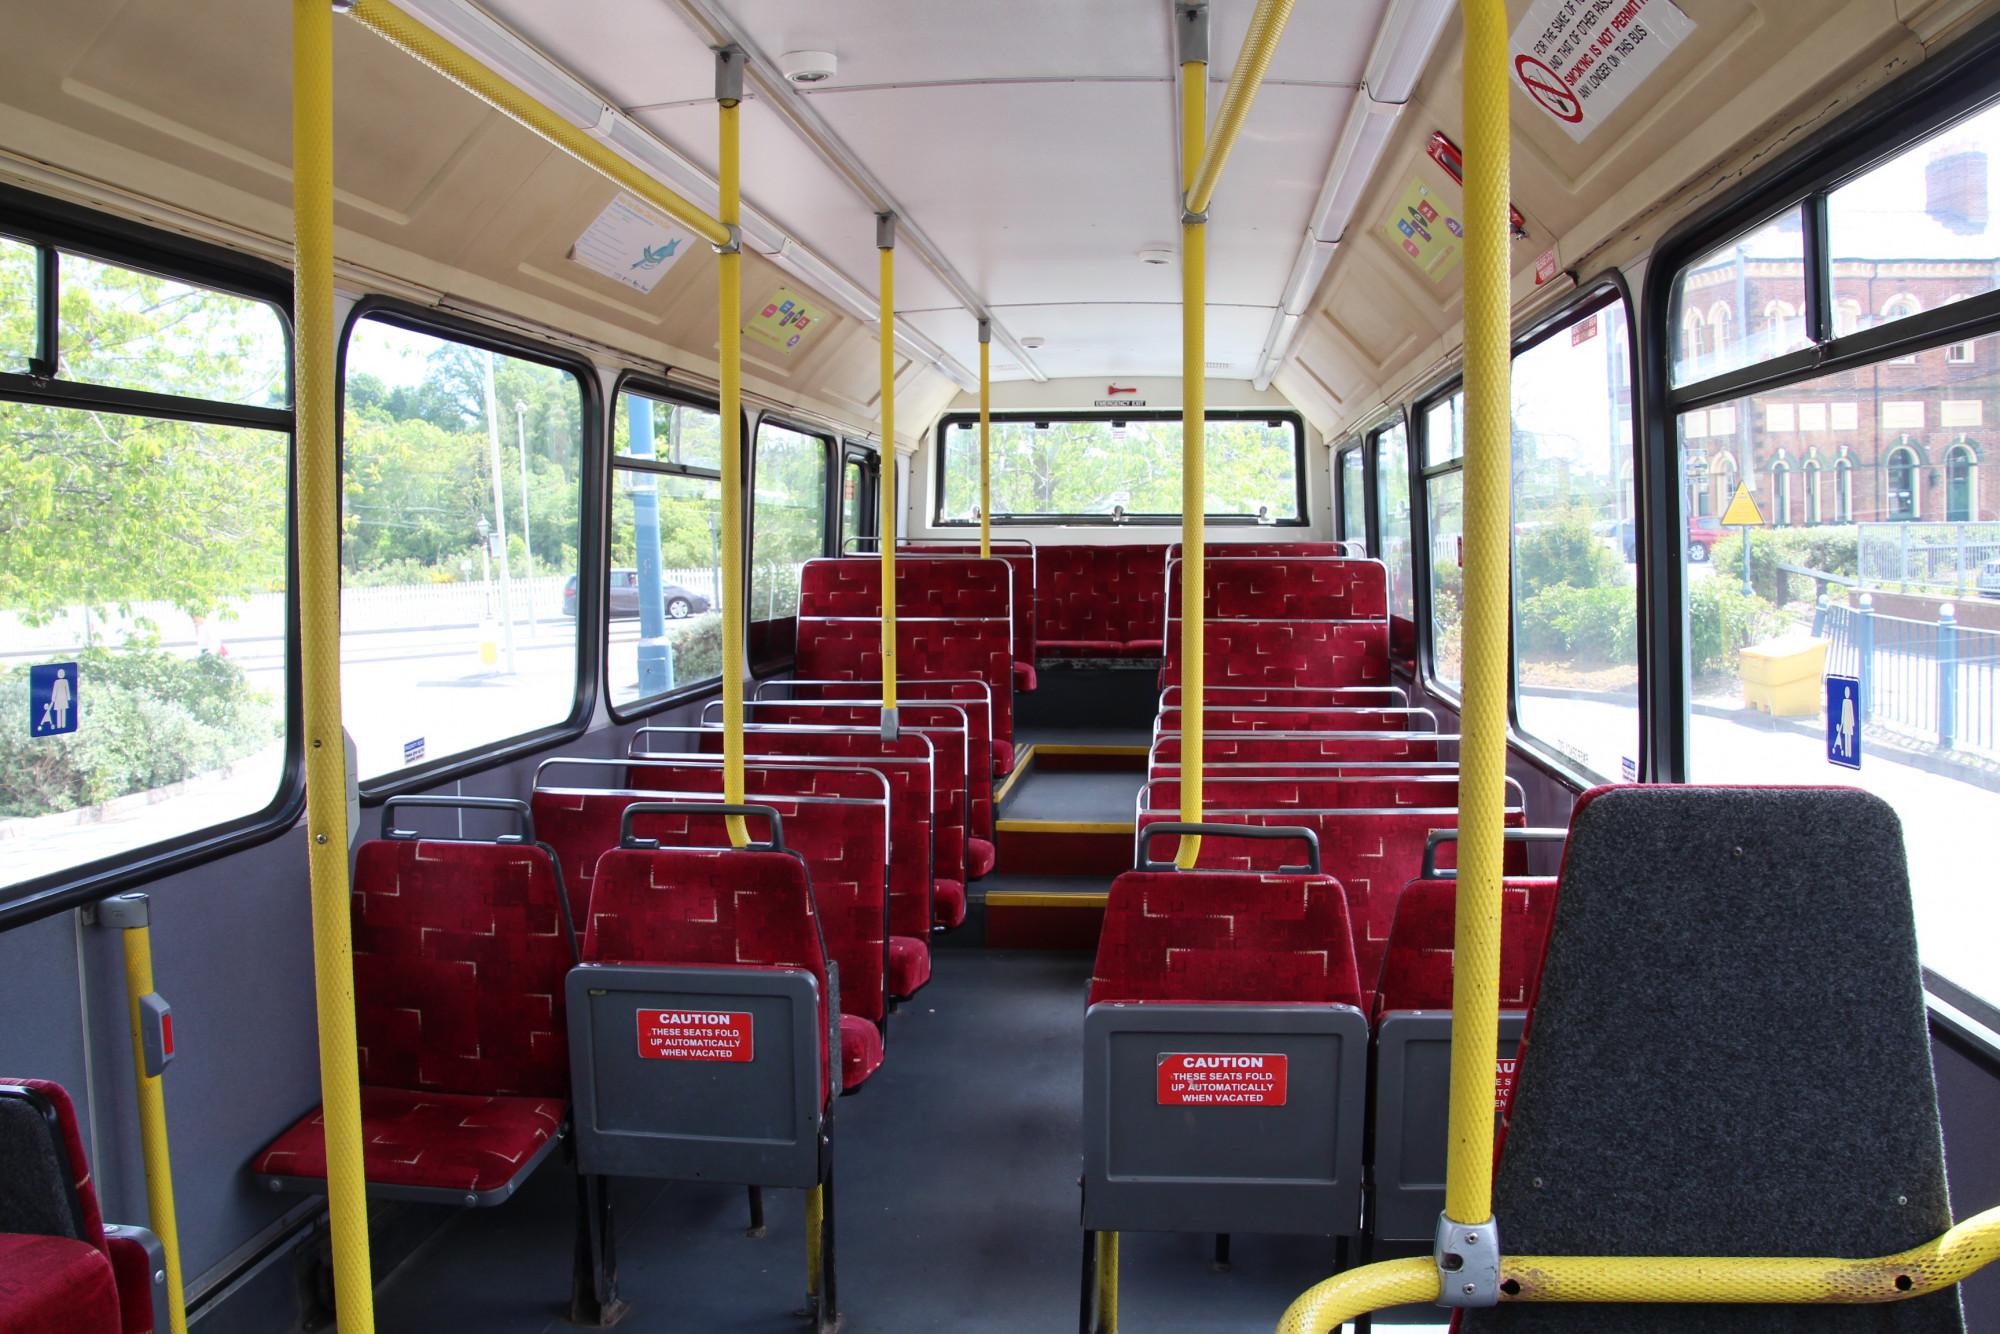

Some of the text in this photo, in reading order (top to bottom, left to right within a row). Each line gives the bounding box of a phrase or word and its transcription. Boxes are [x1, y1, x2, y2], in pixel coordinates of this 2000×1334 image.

[1533, 0, 1577, 57] FOR THE SAKE OF
[1548, 54, 1563, 72] AND
[1557, 39, 1575, 59] THAT
[1569, 30, 1582, 45] OF
[1576, 10, 1599, 36] OTHER
[1564, 53, 1595, 87] SMOKING
[1589, 44, 1602, 58] IS
[1596, 27, 1616, 49] NOT
[1577, 24, 1648, 100] ANY LONGER ON THIS BUS
[659, 1013, 730, 1025] CAUTION
[651, 1027, 740, 1037] THESE SEATS FOLD
[650, 1038, 741, 1048] UP AUTOMATICALLY
[660, 1048, 733, 1058] WHEN VACATED
[1183, 1057, 1264, 1068] CAUTION
[1173, 1072, 1273, 1081] THESE SEATS FOLD
[1171, 1083, 1274, 1092] UP AUTOMATICALLY
[1182, 1094, 1264, 1102] WHEN VACATED
